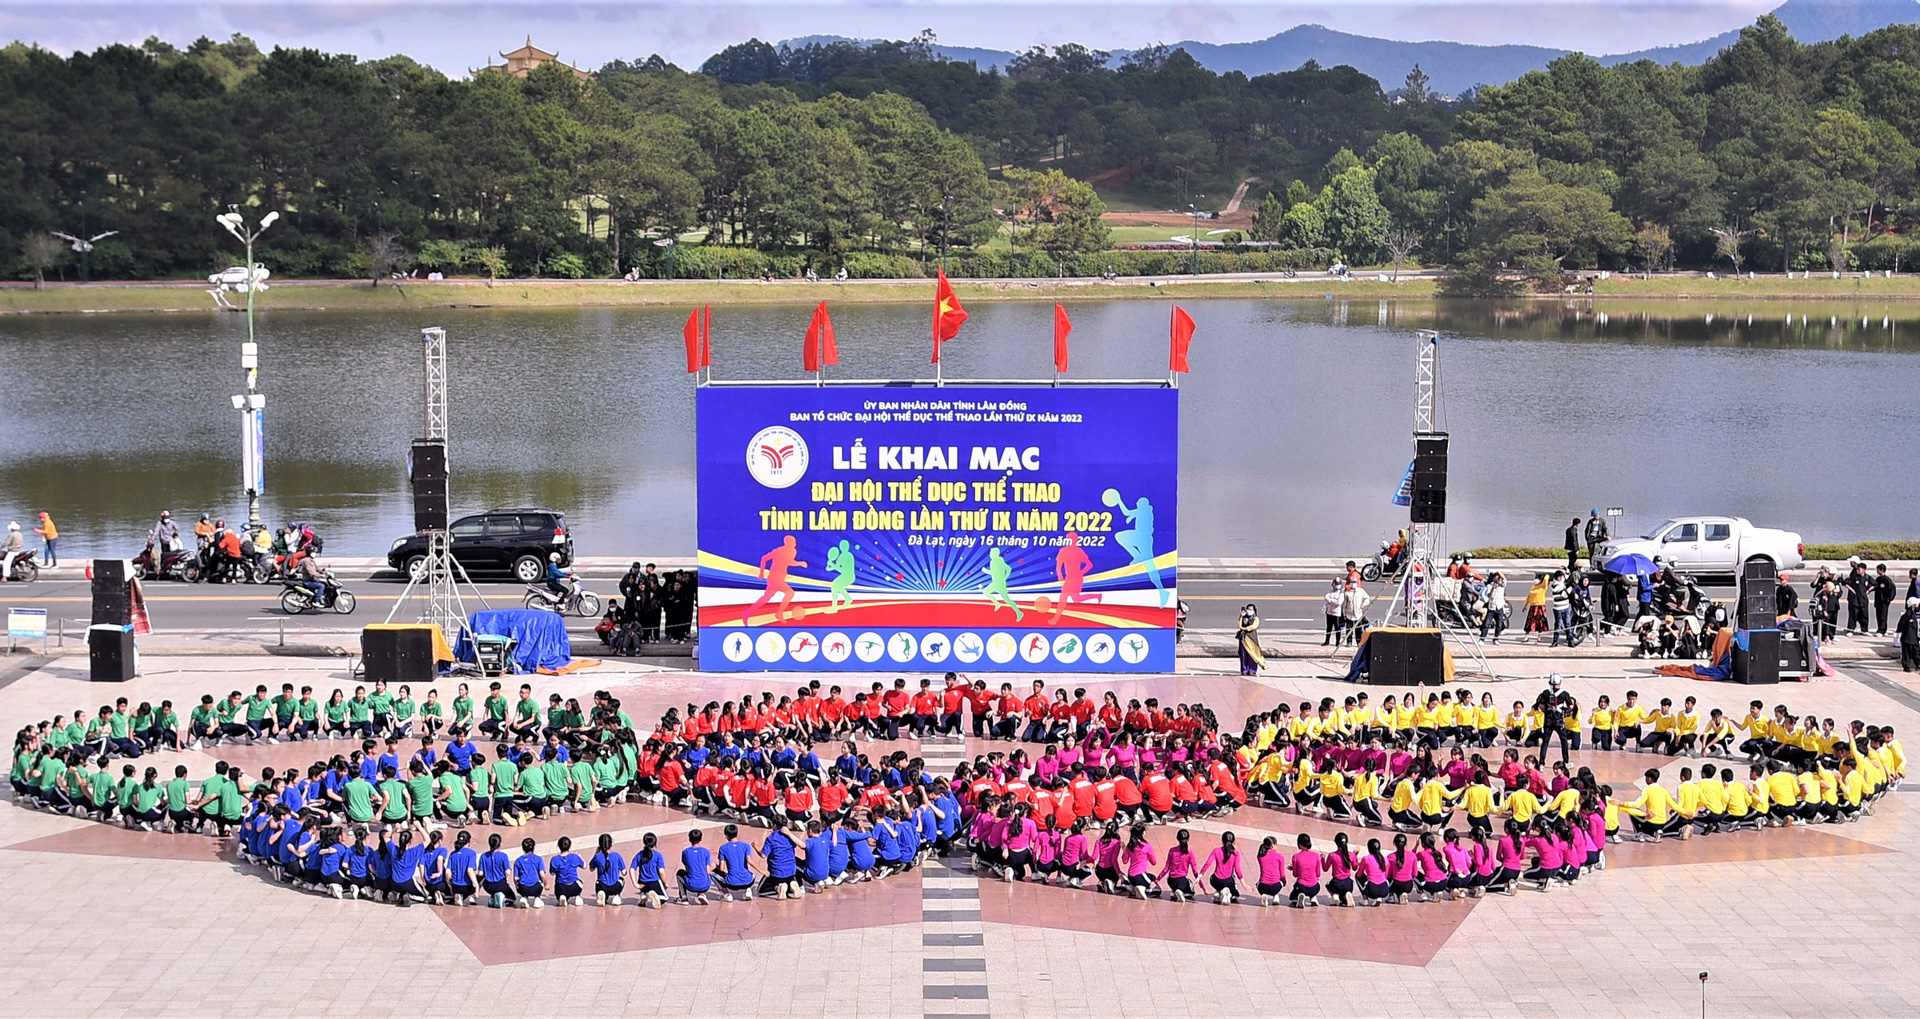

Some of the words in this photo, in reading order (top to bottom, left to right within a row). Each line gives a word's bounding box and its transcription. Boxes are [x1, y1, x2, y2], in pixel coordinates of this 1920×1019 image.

[789, 412, 811, 421] BAN
[826, 411, 853, 421] CHỨC
[854, 412, 872, 423] ĐẠI
[873, 411, 892, 423] HỘI
[892, 410, 912, 421] THỂ
[912, 412, 934, 423] DỤC
[935, 410, 954, 421] THỂ
[955, 413, 982, 422] THAO
[983, 411, 1003, 422] LẦN
[1004, 411, 1025, 422] THỨ
[1026, 413, 1036, 422] IX
[1037, 412, 1060, 423] NĂM
[1060, 413, 1083, 423] 2022
[863, 400, 877, 411] ỦY
[878, 401, 899, 411] BAN
[900, 400, 928, 411] NHÂN
[930, 400, 951, 411] DÂN
[977, 400, 997, 411] LÂM
[998, 400, 1027, 411] ĐỒNG
[833, 437, 867, 469] LỄ
[879, 446, 958, 469] KHAI
[969, 446, 1040, 476] MẠC
[811, 481, 844, 505] ĐẠI
[849, 478, 882, 505] HỘI
[887, 475, 922, 502] THỂ
[927, 482, 967, 506] DỤC
[972, 475, 1006, 502] THỂ
[1011, 482, 1061, 503] THAO
[759, 506, 804, 530] TỈNH
[808, 507, 847, 531] LÂM
[852, 504, 905, 531] ĐỒNG
[910, 504, 944, 531] LẦN
[949, 507, 989, 531] THỨ
[992, 511, 1012, 531] IX
[1016, 508, 1059, 532] NĂM
[1063, 511, 1112, 532] 2022
[908, 534, 923, 546] Đà
[925, 535, 946, 548] Lạt,
[948, 536, 977, 550] ngày
[980, 535, 994, 547] 16
[997, 535, 1029, 550] tháng
[1032, 536, 1047, 547] 10
[1049, 536, 1073, 547] năm
[1075, 536, 1106, 547] 2022
